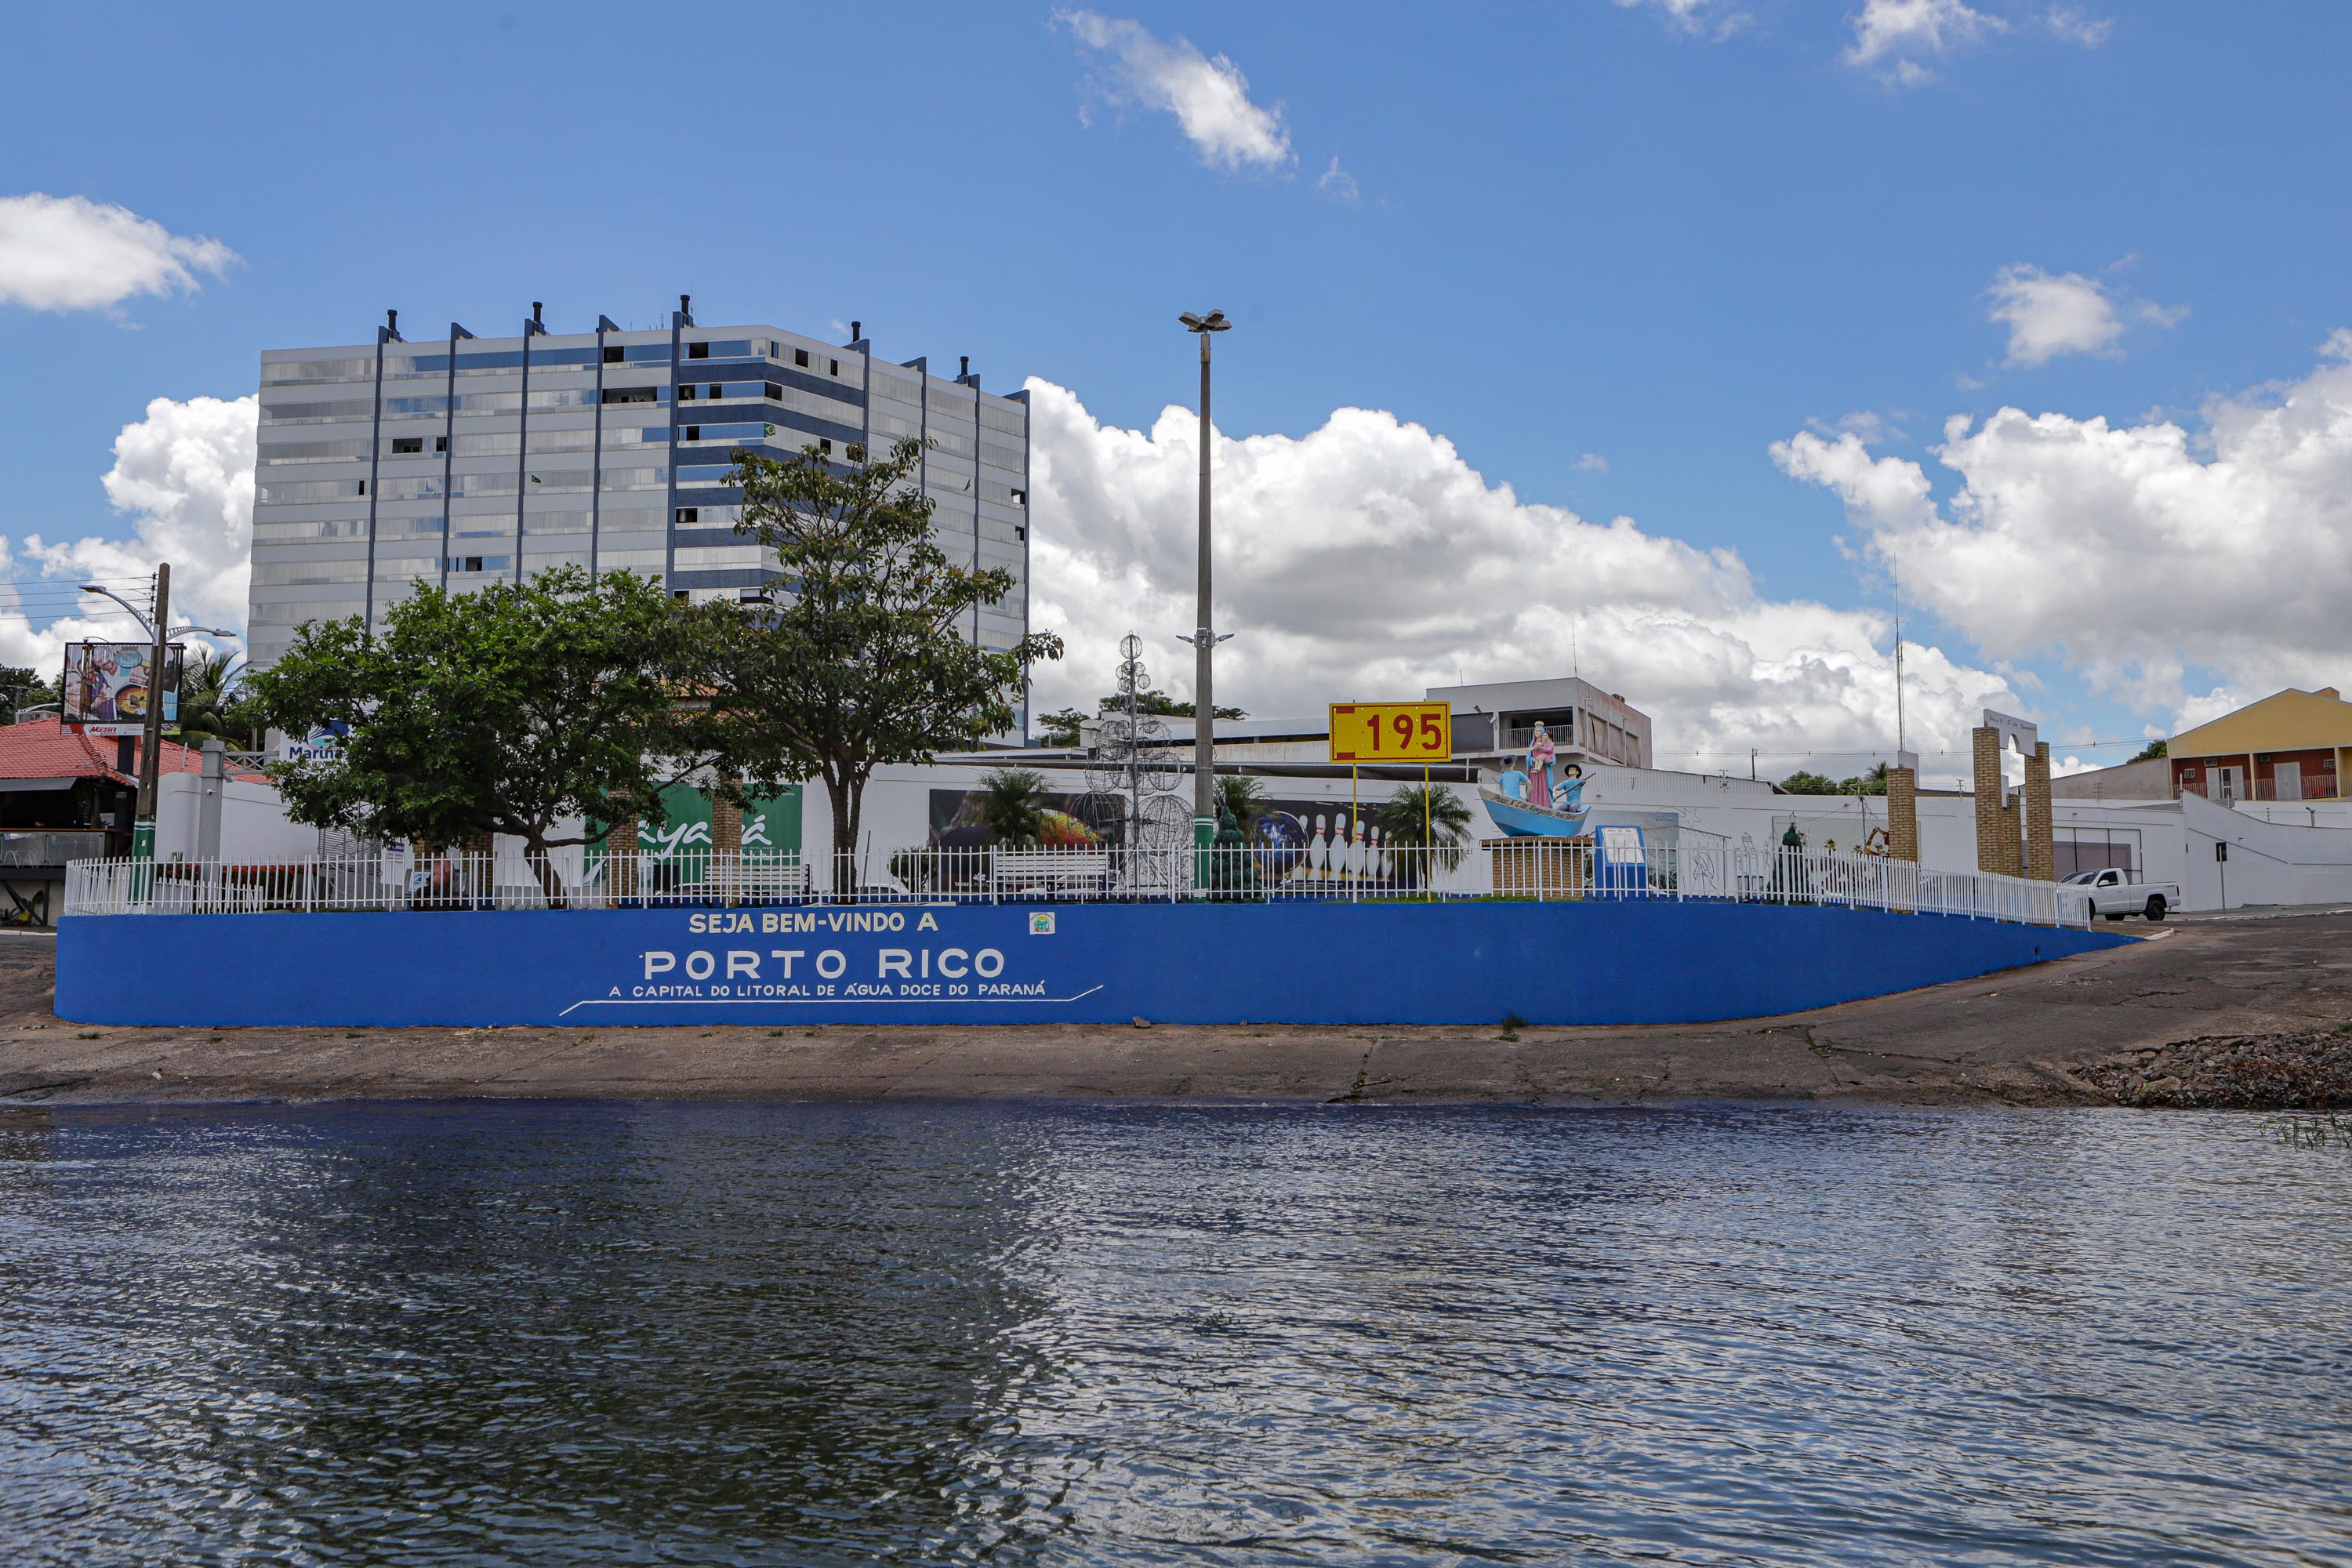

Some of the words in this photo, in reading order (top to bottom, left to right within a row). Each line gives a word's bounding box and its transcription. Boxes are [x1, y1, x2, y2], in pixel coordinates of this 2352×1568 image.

[1367, 713, 1442, 751] 195
[289, 746, 344, 760] Marin
[688, 913, 755, 934] SEJA
[762, 912, 905, 933] BEM-VINDO
[916, 912, 938, 931] A
[644, 949, 847, 980] PORTO
[878, 948, 1004, 978] RICO
[608, 985, 621, 997] A
[633, 985, 703, 997] CAPITAL
[710, 985, 730, 996] DO
[737, 985, 811, 996] LITORAL
[817, 984, 835, 996] DE
[844, 982, 893, 996] ÁGUA
[900, 984, 941, 996] DOCE
[949, 984, 968, 996] DO
[978, 980, 1046, 996] PARANÁ
